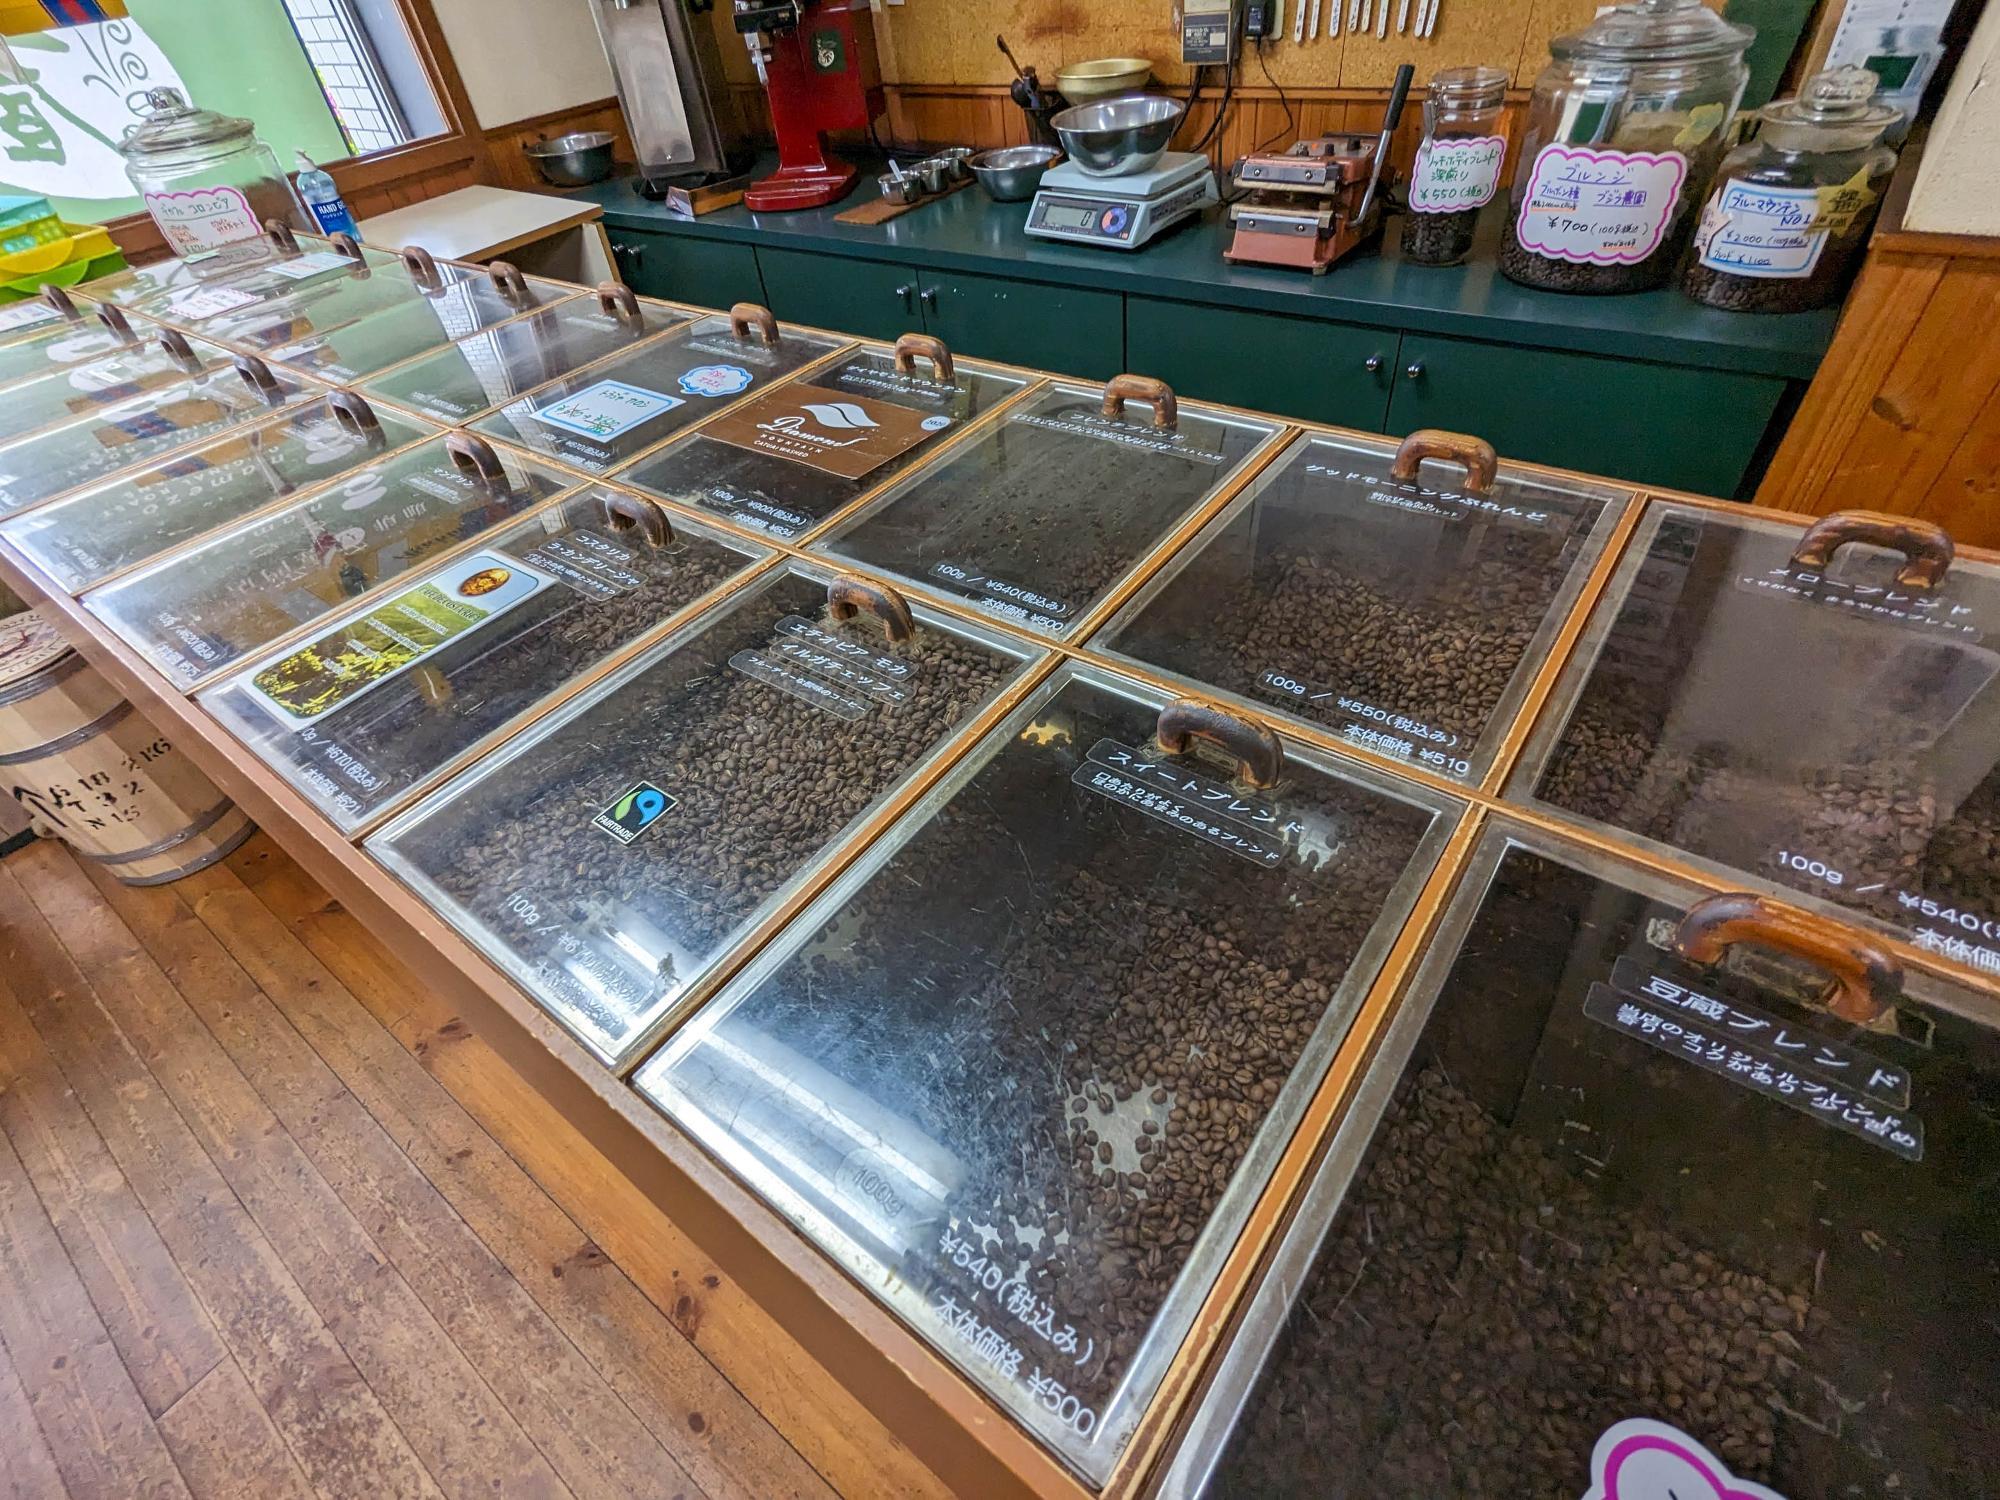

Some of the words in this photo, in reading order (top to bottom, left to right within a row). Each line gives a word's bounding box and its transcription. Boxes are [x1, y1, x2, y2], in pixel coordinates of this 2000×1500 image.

[317, 203, 338, 215] HAND
[1080, 211, 1093, 226] 0
[1548, 216, 1588, 233] ¥700
[760, 433, 823, 454] MOUNTAIN
[779, 445, 809, 457] WASHED
[575, 535, 631, 561] コスタリカ
[937, 564, 966, 580] 100g
[985, 580, 1067, 613] ¥540(税込み)
[1768, 568, 1973, 616] メローブレンド
[981, 597, 1029, 619] 本体価格
[1030, 613, 1064, 631] ¥500
[790, 623, 869, 656] エチオピア
[876, 657, 908, 675] モカ
[782, 643, 906, 700] イルガチェッフェ
[1264, 673, 1307, 695] 100g
[1337, 697, 1459, 747] ¥550(税込み)
[139, 737, 172, 762] KG
[1344, 723, 1415, 756] 本体価格
[1419, 748, 1470, 775] ¥510
[1094, 771, 1185, 811] 口あたりがよく
[1108, 751, 1306, 834] スイートブレンド
[597, 814, 634, 840] FAIRTRADE
[1778, 850, 1844, 885] 100g
[507, 894, 541, 926] 100g
[1640, 975, 1901, 1090] 豆蔵ブレンド
[939, 1230, 1095, 1366] ¥540(税込み)
[933, 1294, 1025, 1382] 本体価格
[1027, 1366, 1097, 1438] ¥500
